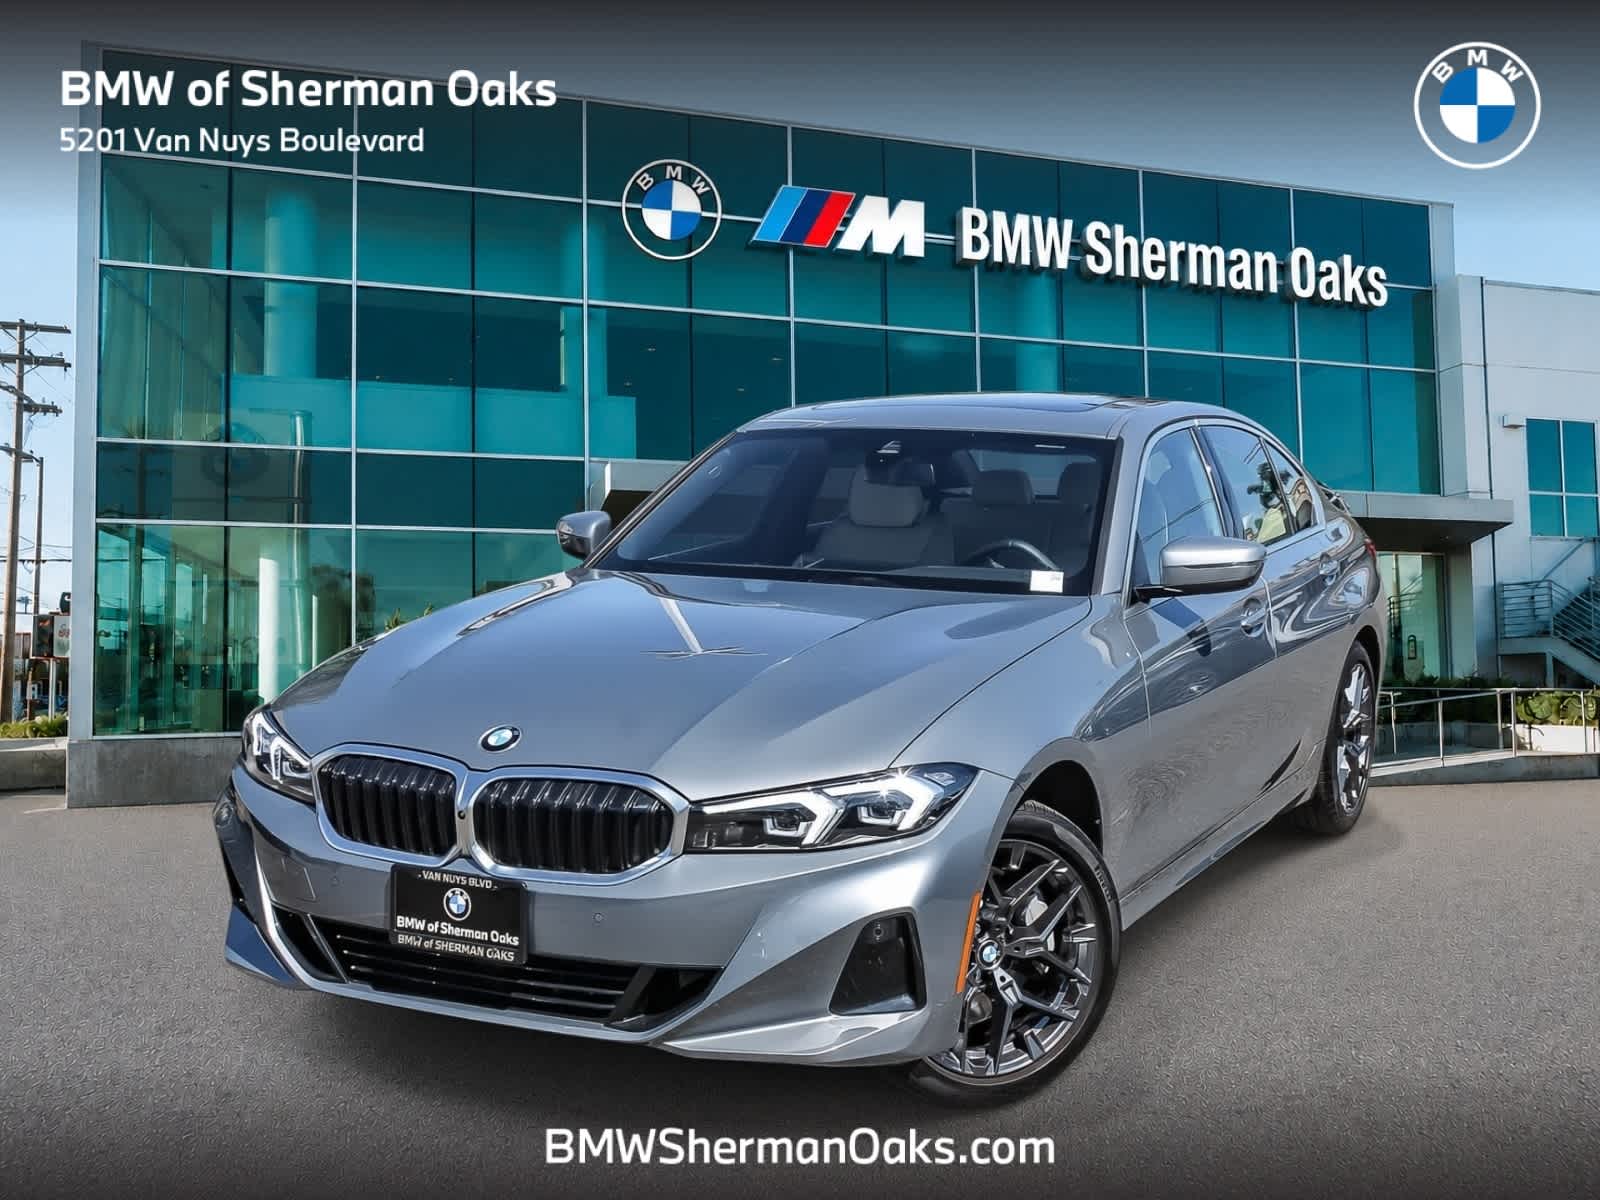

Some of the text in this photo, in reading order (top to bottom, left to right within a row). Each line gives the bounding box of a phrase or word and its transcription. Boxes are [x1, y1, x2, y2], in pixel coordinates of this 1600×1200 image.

[636, 165, 710, 196] BMW
[958, 206, 1388, 309] BMW Sherman Oaks
[422, 870, 493, 889] VAN NUYS BLVD
[396, 915, 520, 946] BMW of Sherman Oaks
[398, 934, 515, 962] BMW of SHERMAN OAKS
